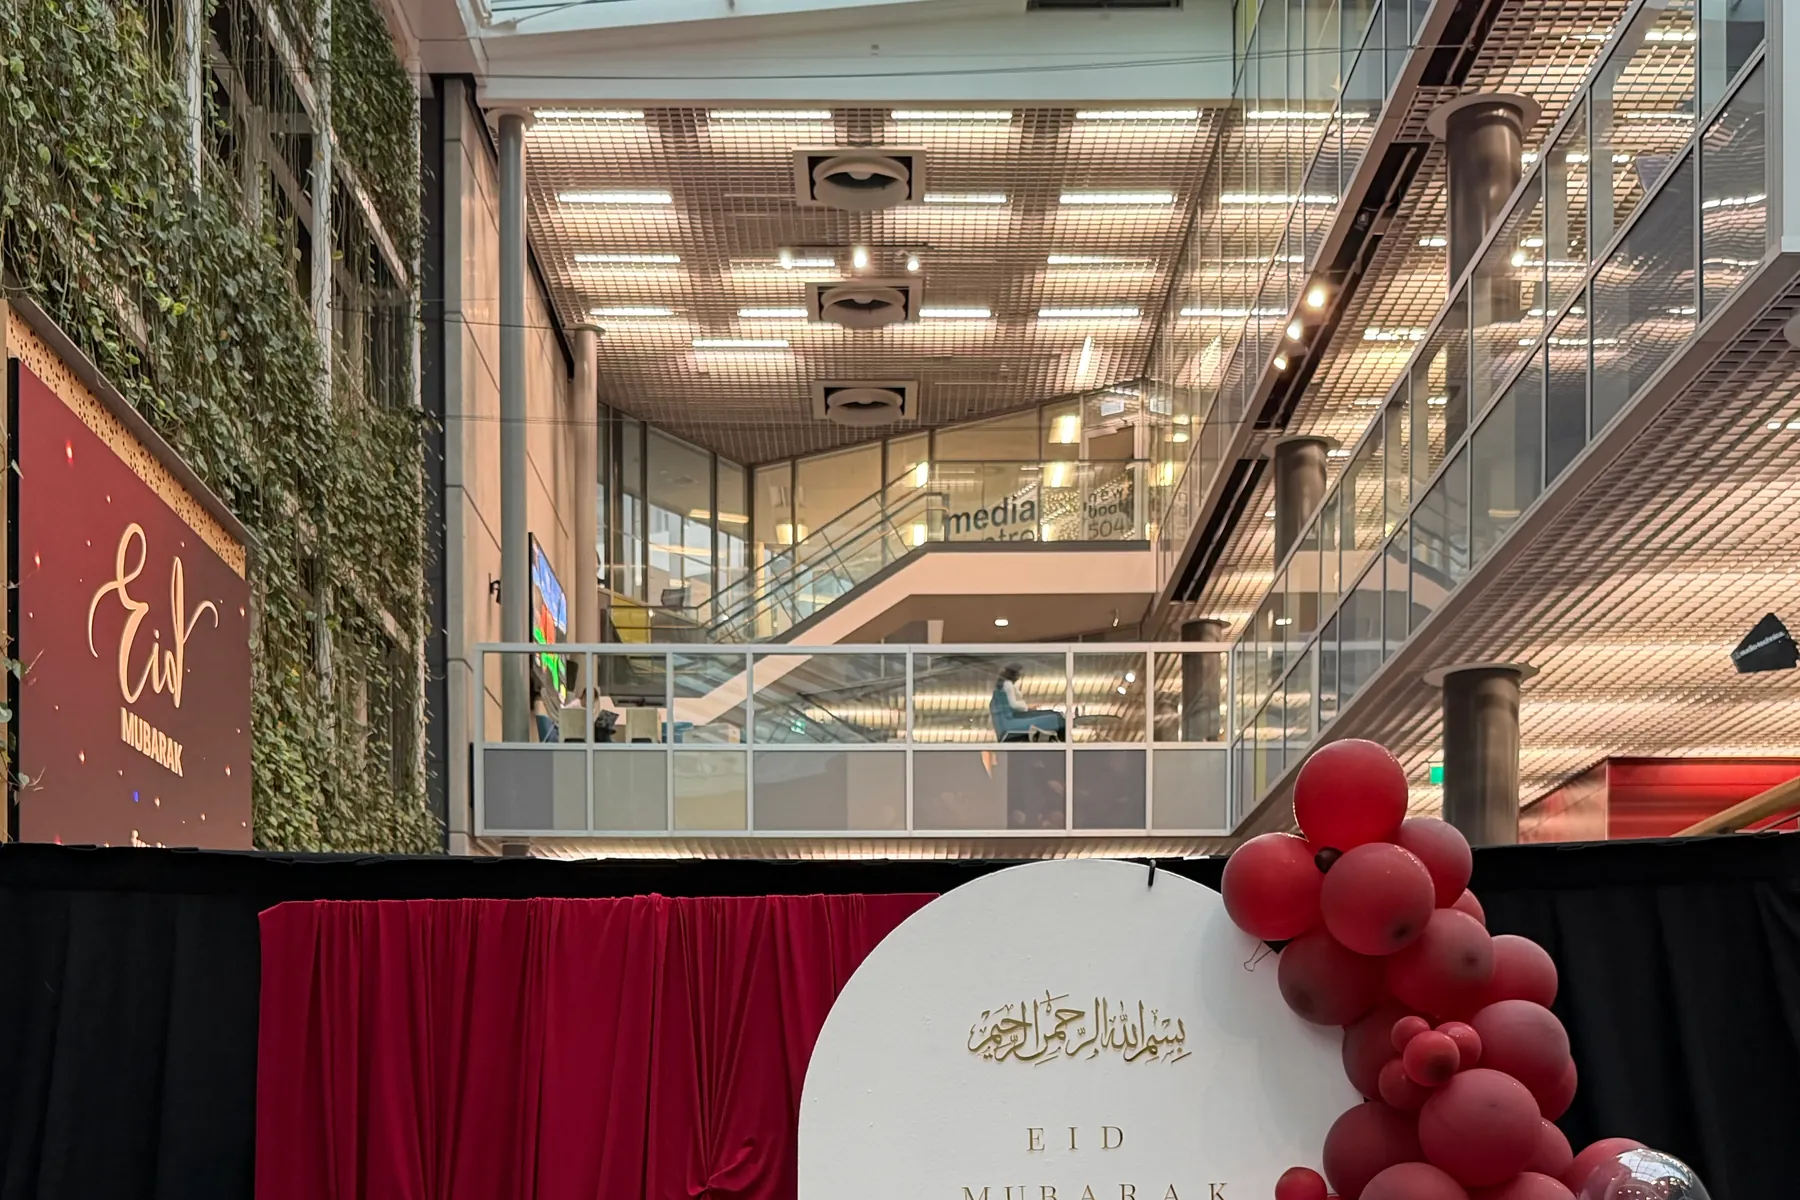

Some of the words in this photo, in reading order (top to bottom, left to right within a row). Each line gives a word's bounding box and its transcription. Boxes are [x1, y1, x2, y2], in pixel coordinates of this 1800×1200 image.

[948, 496, 1035, 534] media
[1088, 517, 1125, 540] 504
[89, 522, 219, 708] Eid
[120, 706, 184, 777] MUBARAK
[1026, 1126, 1125, 1152] EID
